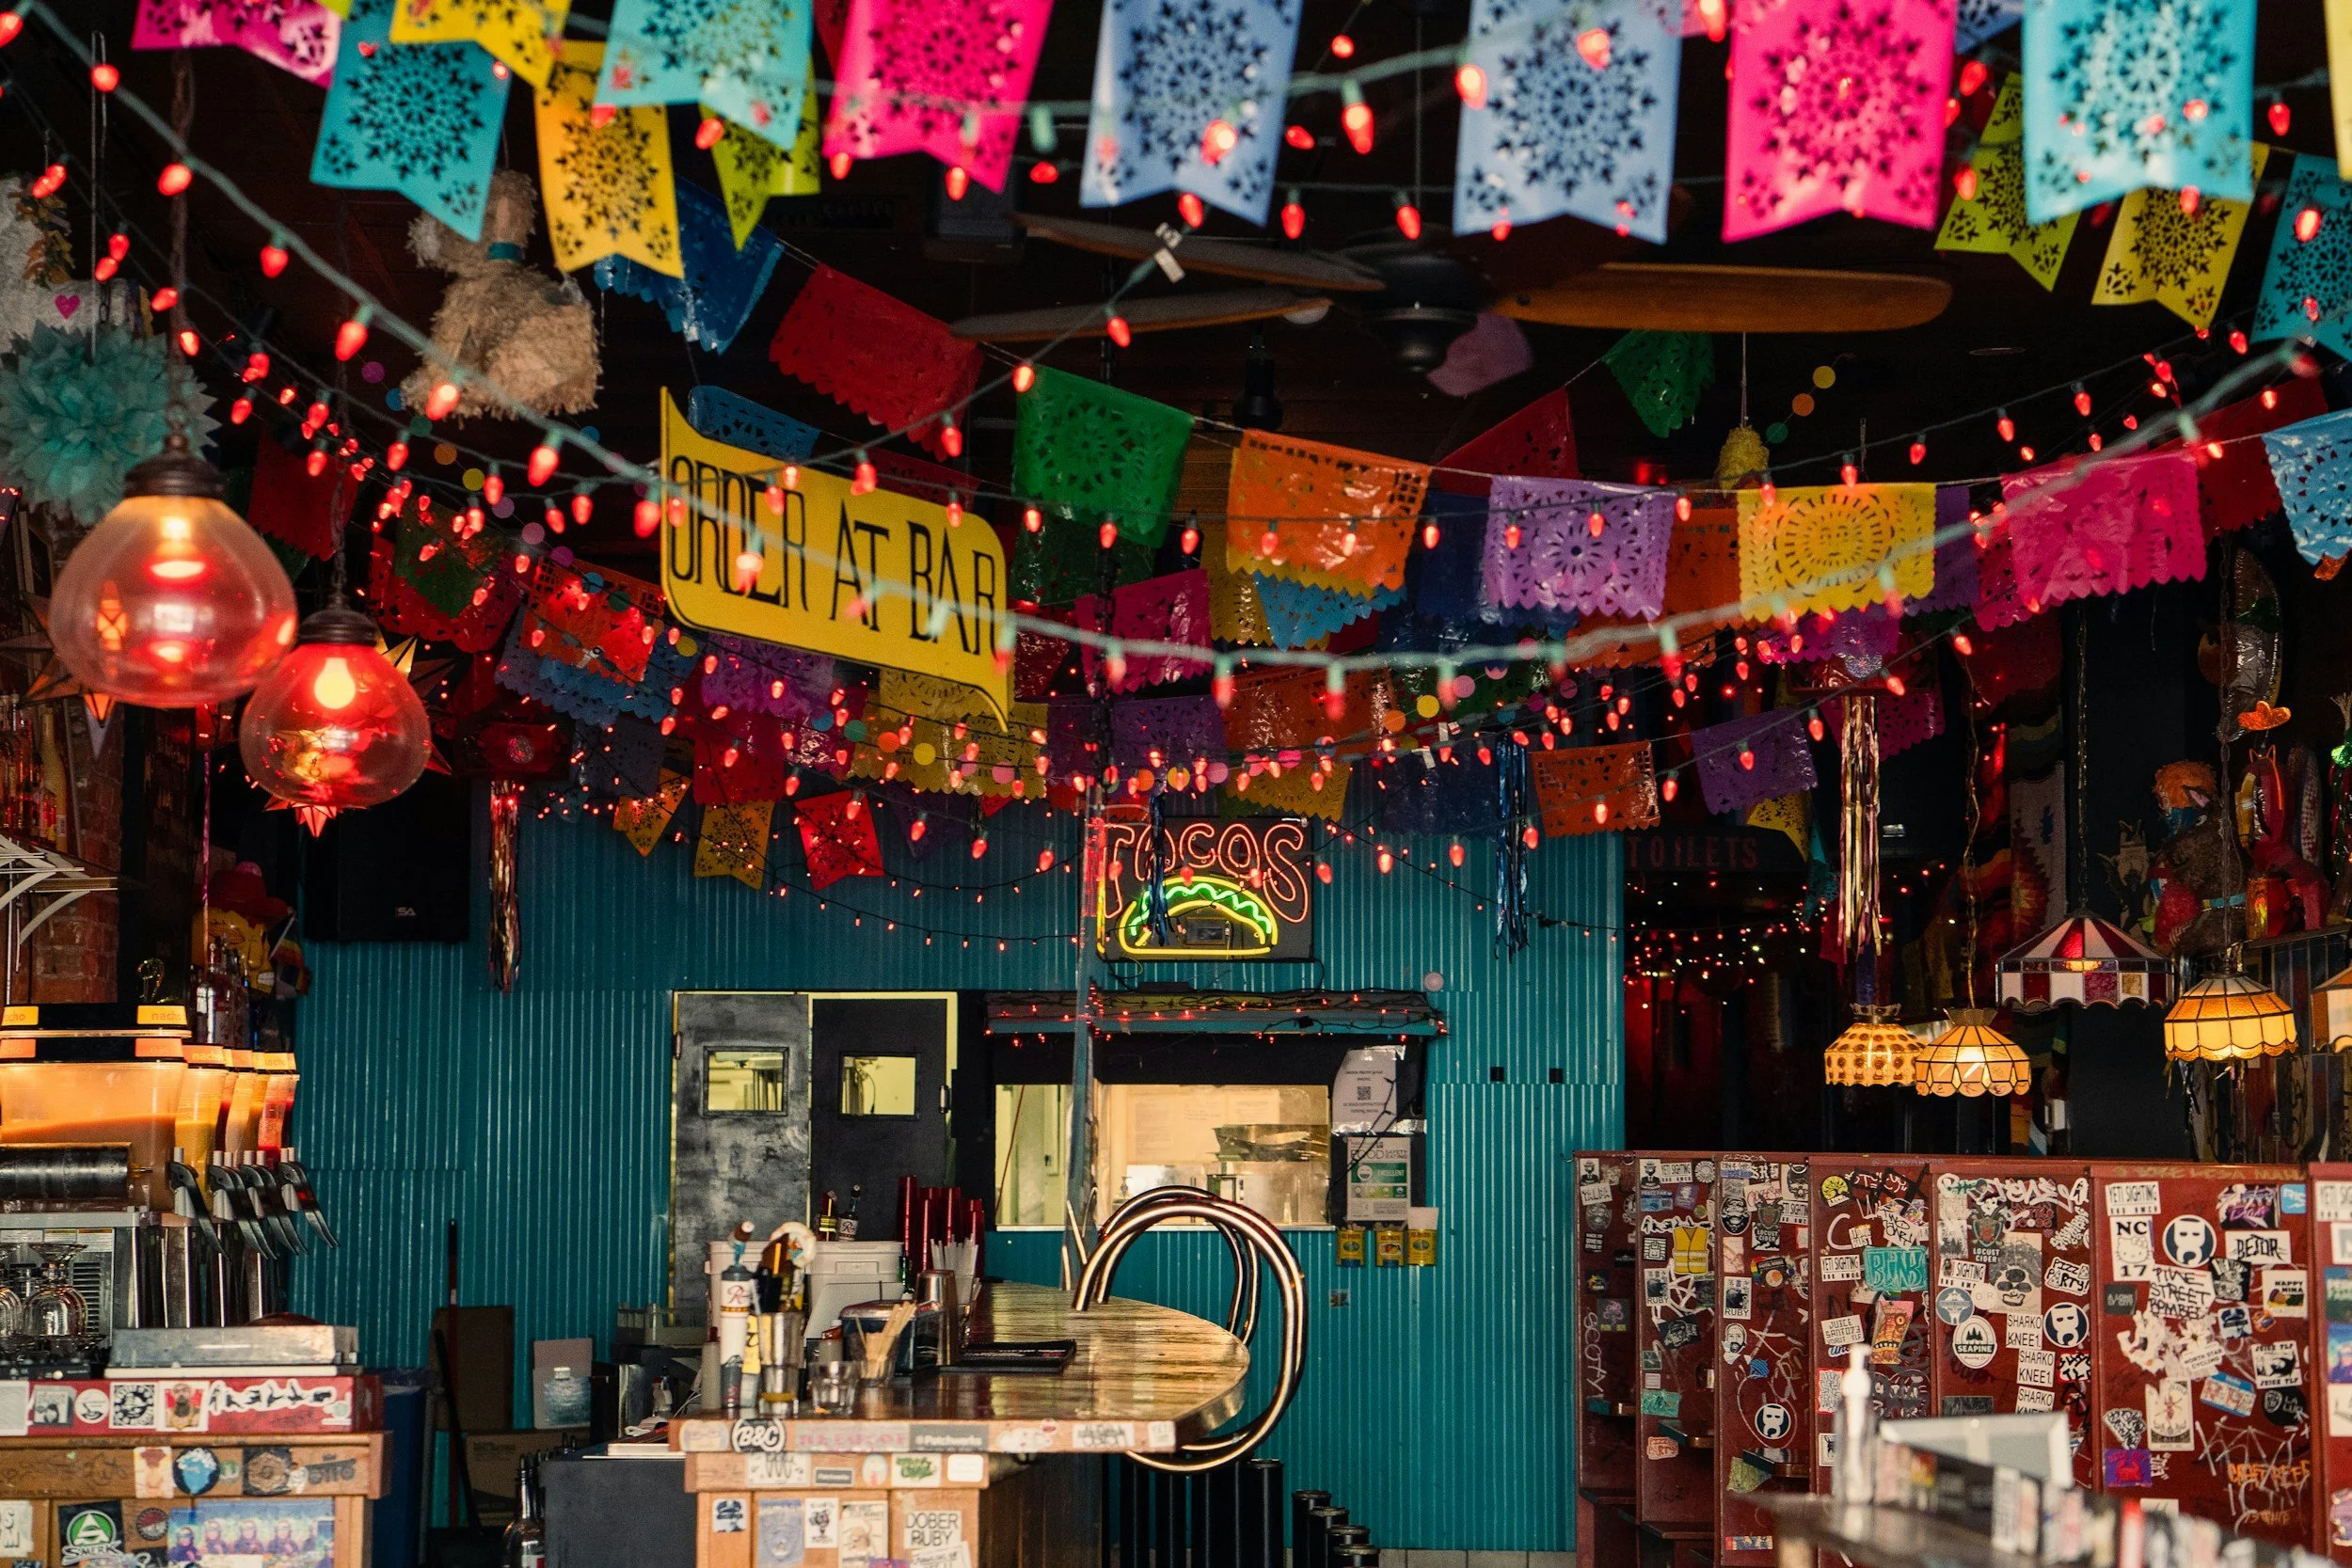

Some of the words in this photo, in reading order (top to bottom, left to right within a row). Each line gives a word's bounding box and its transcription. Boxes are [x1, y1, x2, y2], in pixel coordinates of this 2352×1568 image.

[670, 455, 808, 611] ORDER
[831, 500, 890, 632] AT
[908, 520, 999, 657] BAR
[1628, 836, 1758, 868] TOILETS
[1351, 1149, 1384, 1159] FOOD
[2116, 1222, 2147, 1235] NC
[1835, 1257, 1859, 1270] SIGHTING
[1957, 1262, 1984, 1280] SIGHTING
[2122, 1265, 2146, 1276] 17
[2150, 1282, 2211, 1305] STREET
[1829, 1319, 1852, 1329] JUICE
[906, 1513, 959, 1528] DOBER
[911, 1530, 952, 1545] RUBY
